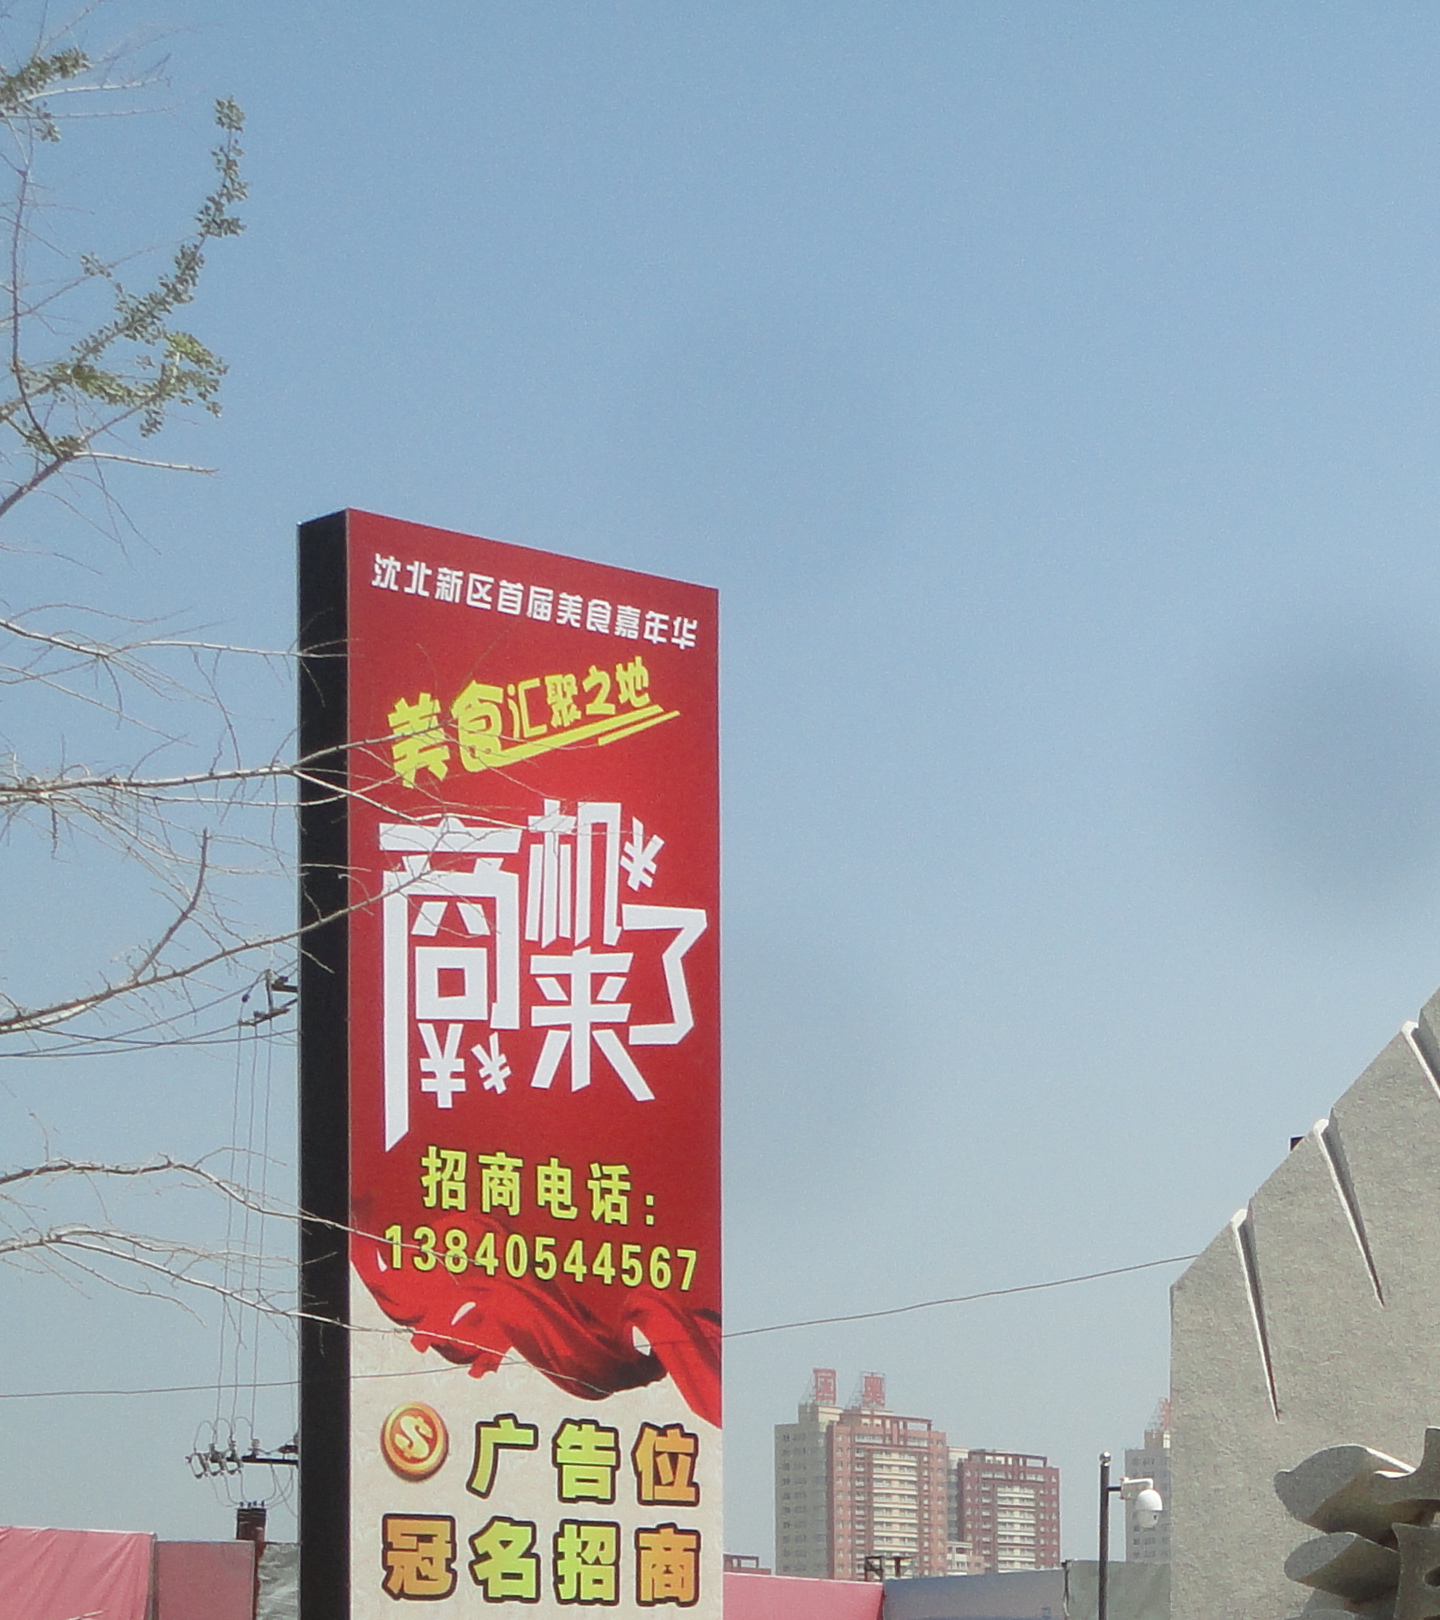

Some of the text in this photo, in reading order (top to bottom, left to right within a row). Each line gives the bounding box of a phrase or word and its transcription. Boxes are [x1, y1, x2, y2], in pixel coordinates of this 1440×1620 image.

[371, 552, 699, 651] 沈北新区首届美食嘉年华
[387, 655, 655, 789] 美食汇聚之地
[384, 1223, 698, 1294] 13840544567
[466, 1413, 702, 1508] 广告位
[380, 1514, 702, 1607] 冠名招商
